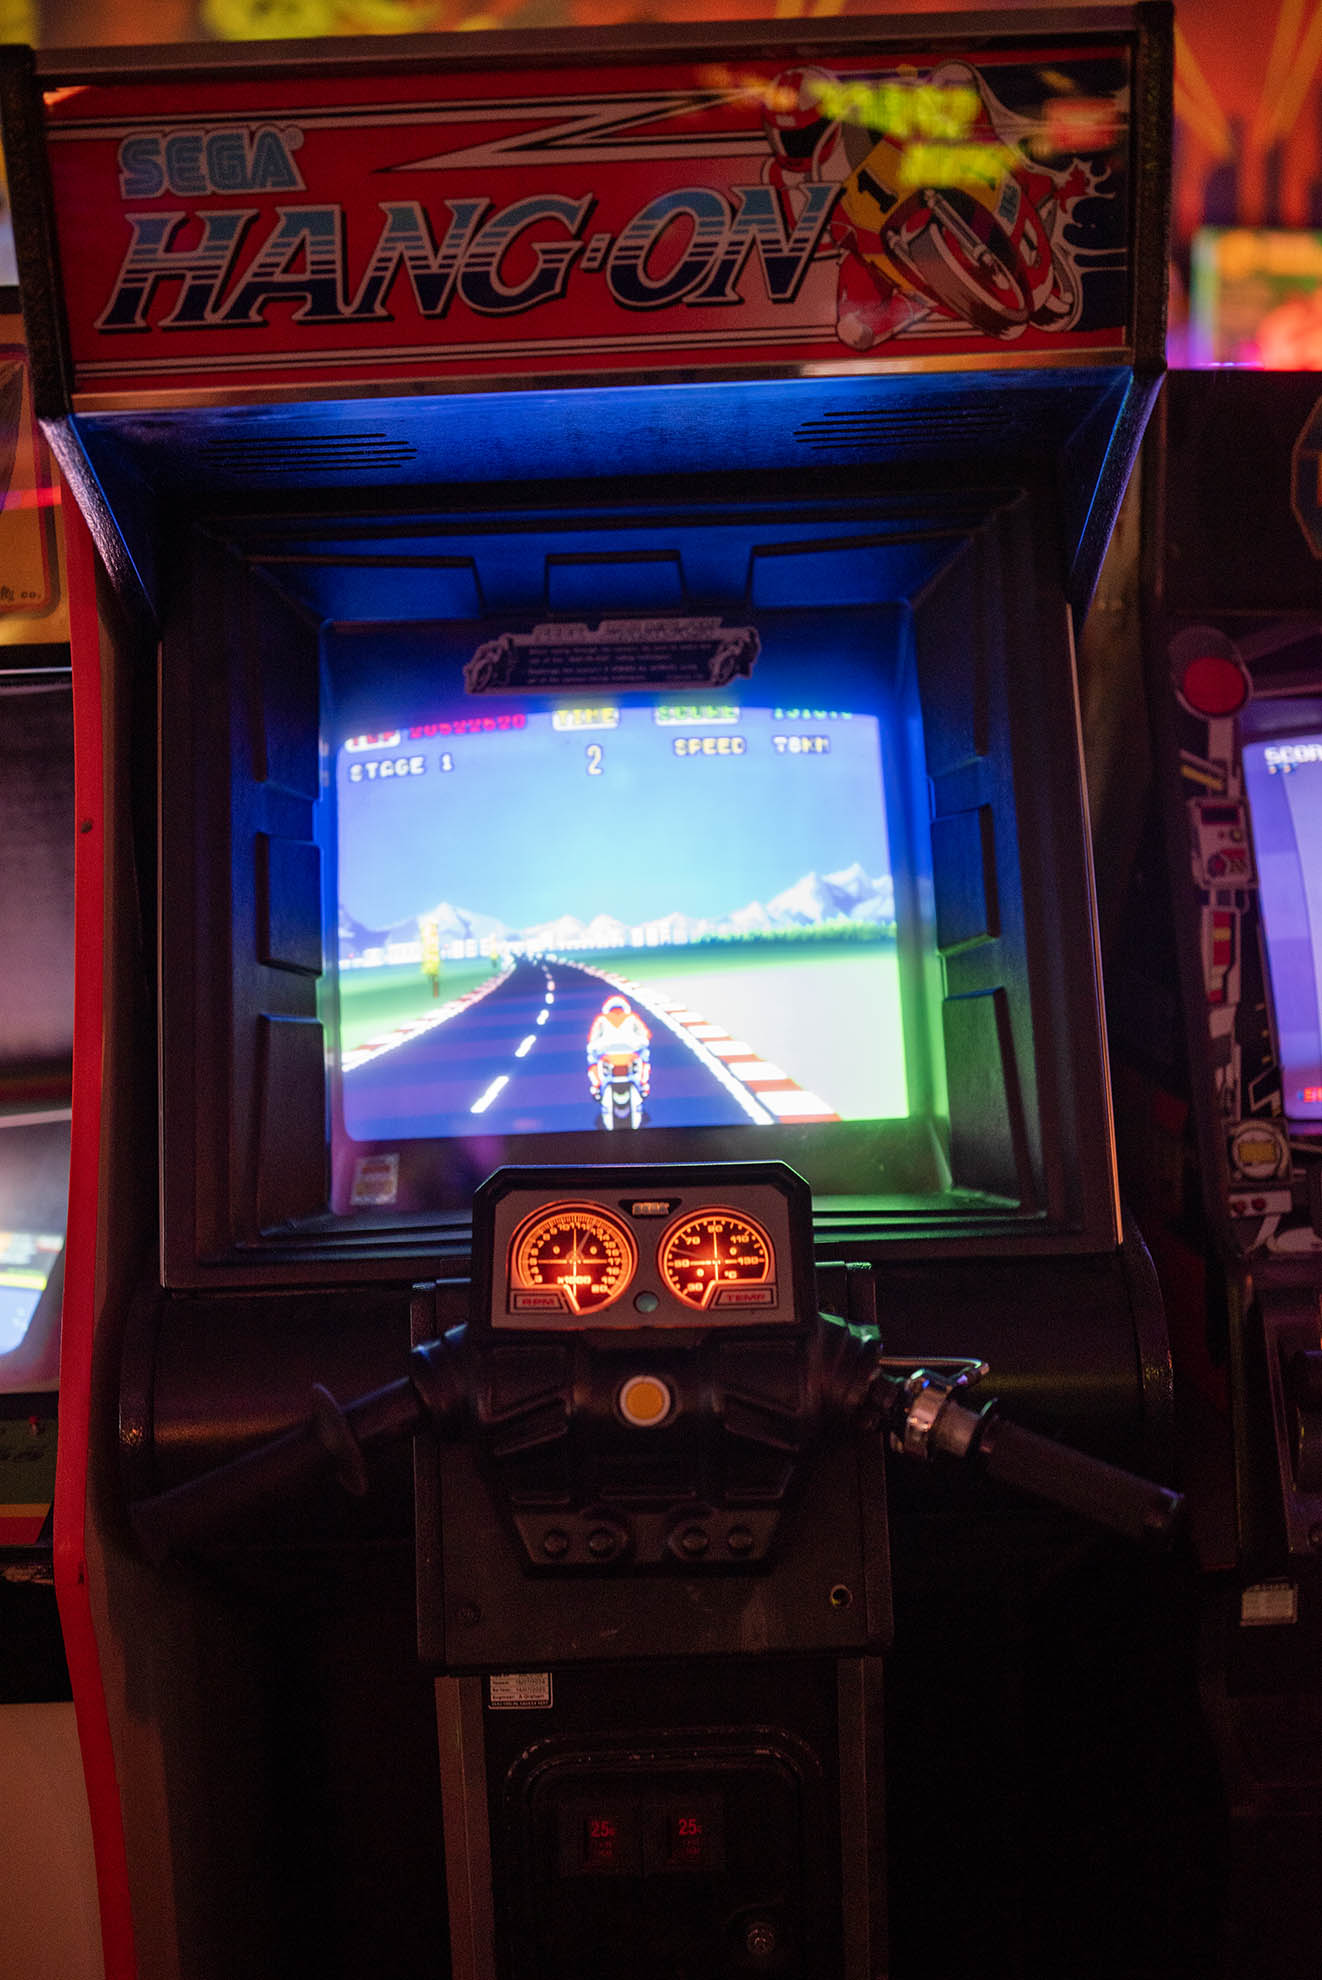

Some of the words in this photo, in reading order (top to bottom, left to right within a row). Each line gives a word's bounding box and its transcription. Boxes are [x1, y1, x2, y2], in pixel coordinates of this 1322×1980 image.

[119, 124, 306, 199] SEGA
[94, 181, 845, 333] HANG-ON
[586, 744, 603, 776] 2
[674, 737, 747, 755] SPEED
[349, 756, 425, 783] STAGE
[440, 752, 454, 772] 1
